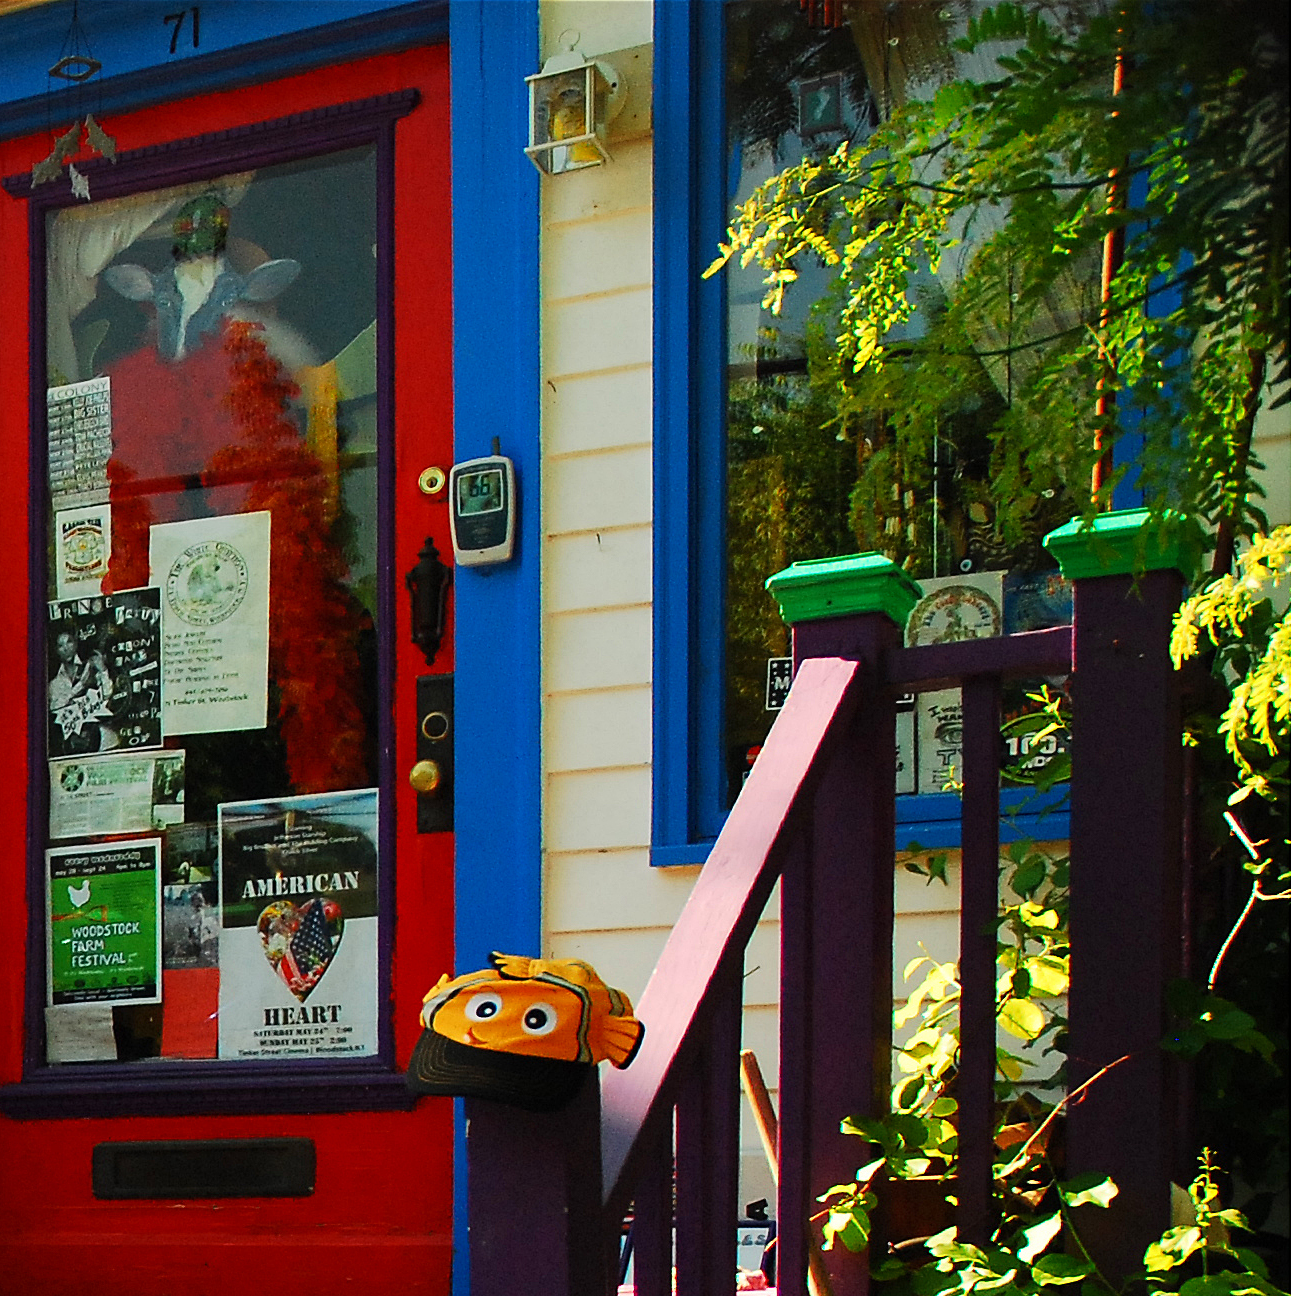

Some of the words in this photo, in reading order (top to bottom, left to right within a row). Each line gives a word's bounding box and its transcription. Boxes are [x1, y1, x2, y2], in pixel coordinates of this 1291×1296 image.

[163, 7, 200, 54] 71
[241, 870, 360, 899] AMERICAN
[71, 921, 140, 938] WOODSTOCK
[71, 939, 105, 953] FARM
[71, 952, 126, 968] FESTIVAL
[263, 1004, 341, 1026] HEART
[253, 1029, 294, 1038] SATURDAY
[296, 1028, 311, 1036] MAY
[259, 1039, 288, 1047] SUNDAY
[292, 1038, 307, 1046] MAY
